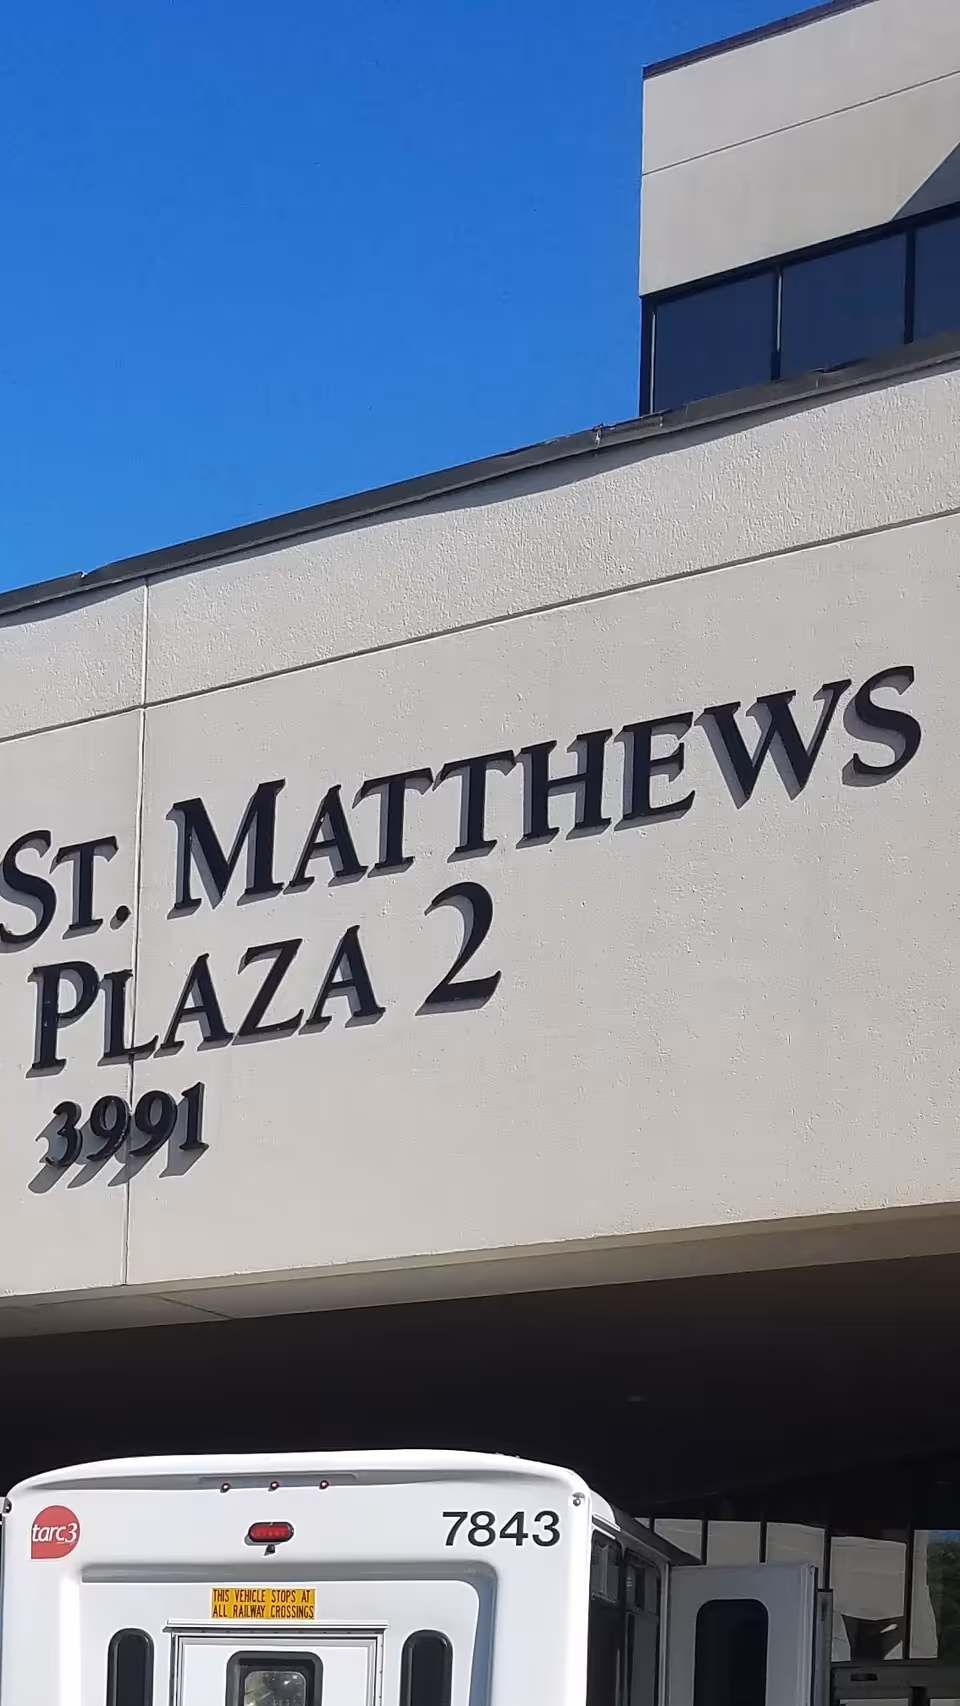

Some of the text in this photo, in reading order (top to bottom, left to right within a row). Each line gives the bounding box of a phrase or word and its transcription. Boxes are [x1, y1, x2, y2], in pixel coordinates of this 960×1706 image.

[171, 665, 922, 912] MATTHEWS
[29, 925, 386, 1074] PLAZA
[421, 881, 502, 1008] 2
[44, 1081, 209, 1168] 3991
[442, 1510, 560, 1547] 7843
[213, 1589, 311, 1603] THIS VEHICLE STOPS AT
[213, 1604, 314, 1619] ALL RAILWAY CROSSINGS
